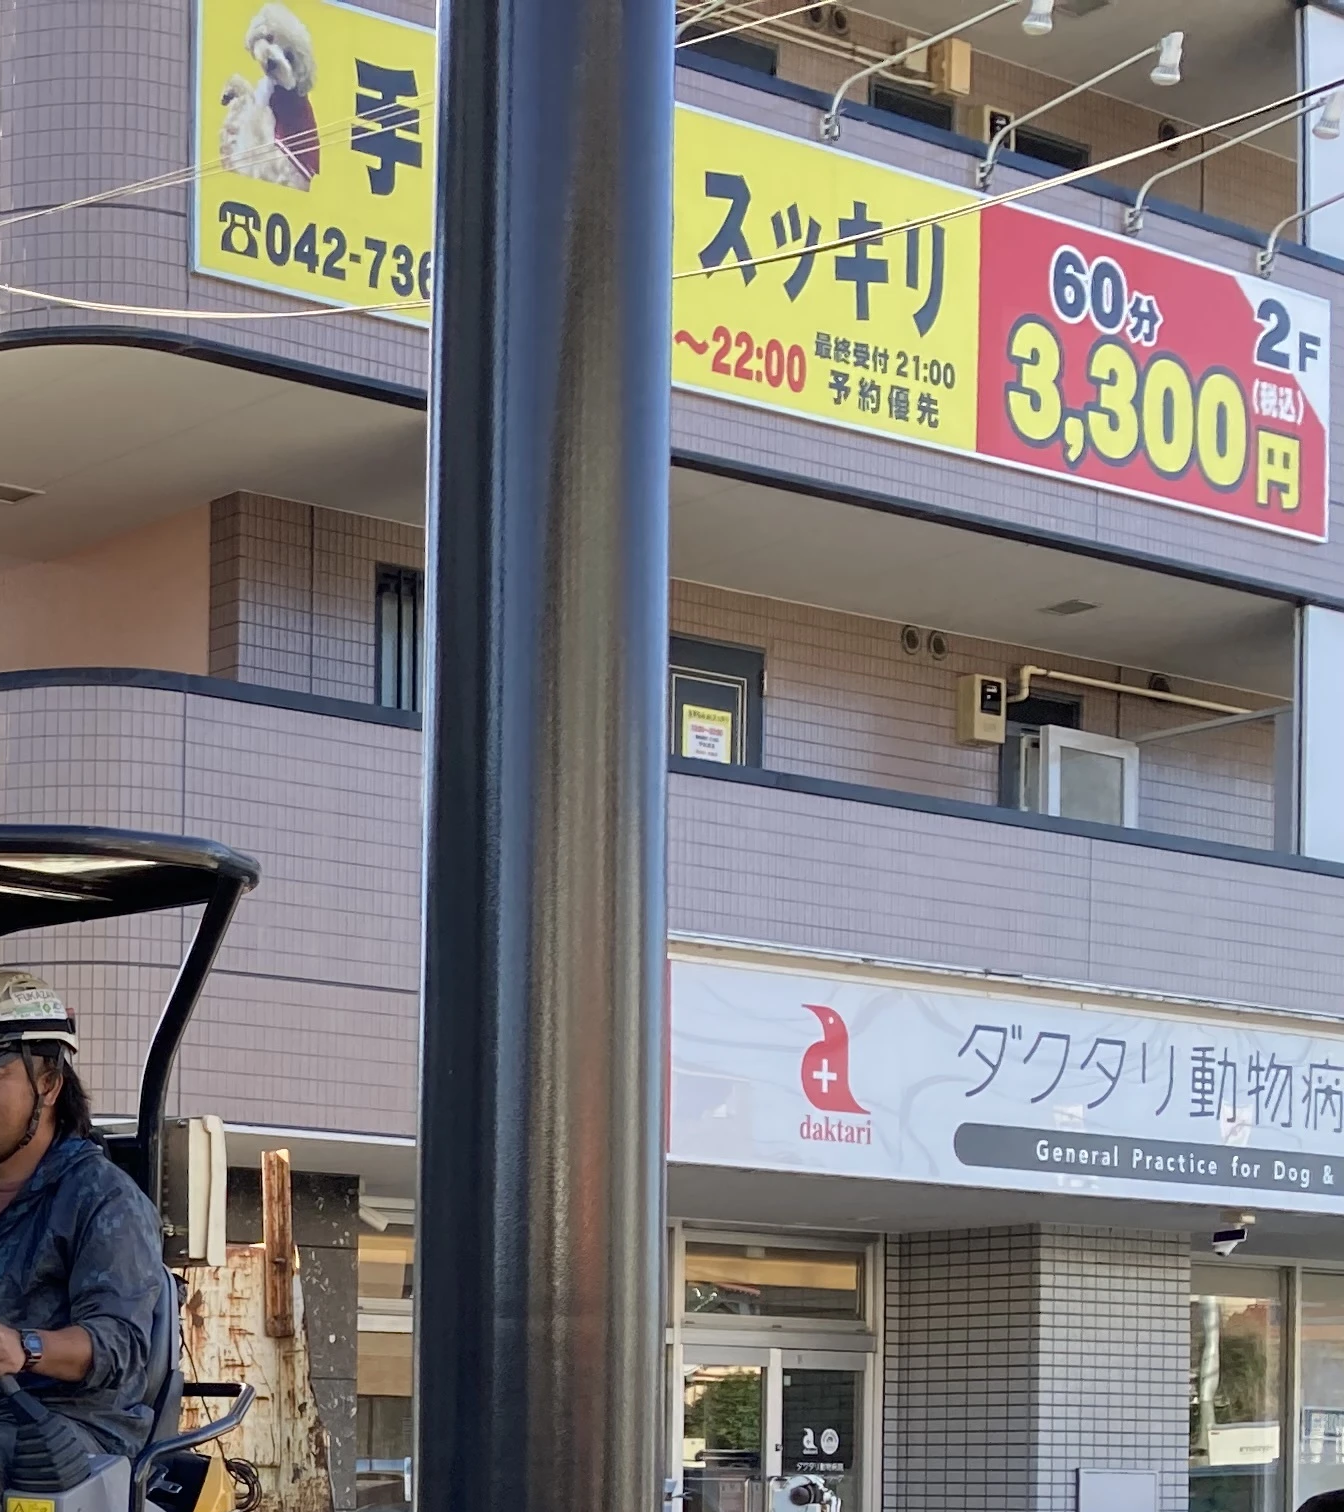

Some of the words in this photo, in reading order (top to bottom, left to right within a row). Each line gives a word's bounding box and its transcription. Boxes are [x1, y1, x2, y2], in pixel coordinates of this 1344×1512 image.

[697, 171, 946, 338] スッキリ
[1050, 244, 1163, 347] 60分
[814, 331, 890, 375] 最終受付
[895, 351, 955, 389] 21:00
[1255, 298, 1321, 372] 2F
[828, 369, 940, 428] 予約優先
[799, 1113, 872, 1146] daktari
[1035, 1139, 1120, 1168] General
[1132, 1150, 1218, 1176] Practice
[1231, 1155, 1262, 1179] for
[1272, 1160, 1311, 1188] Dog
[1322, 1164, 1335, 1186] &
